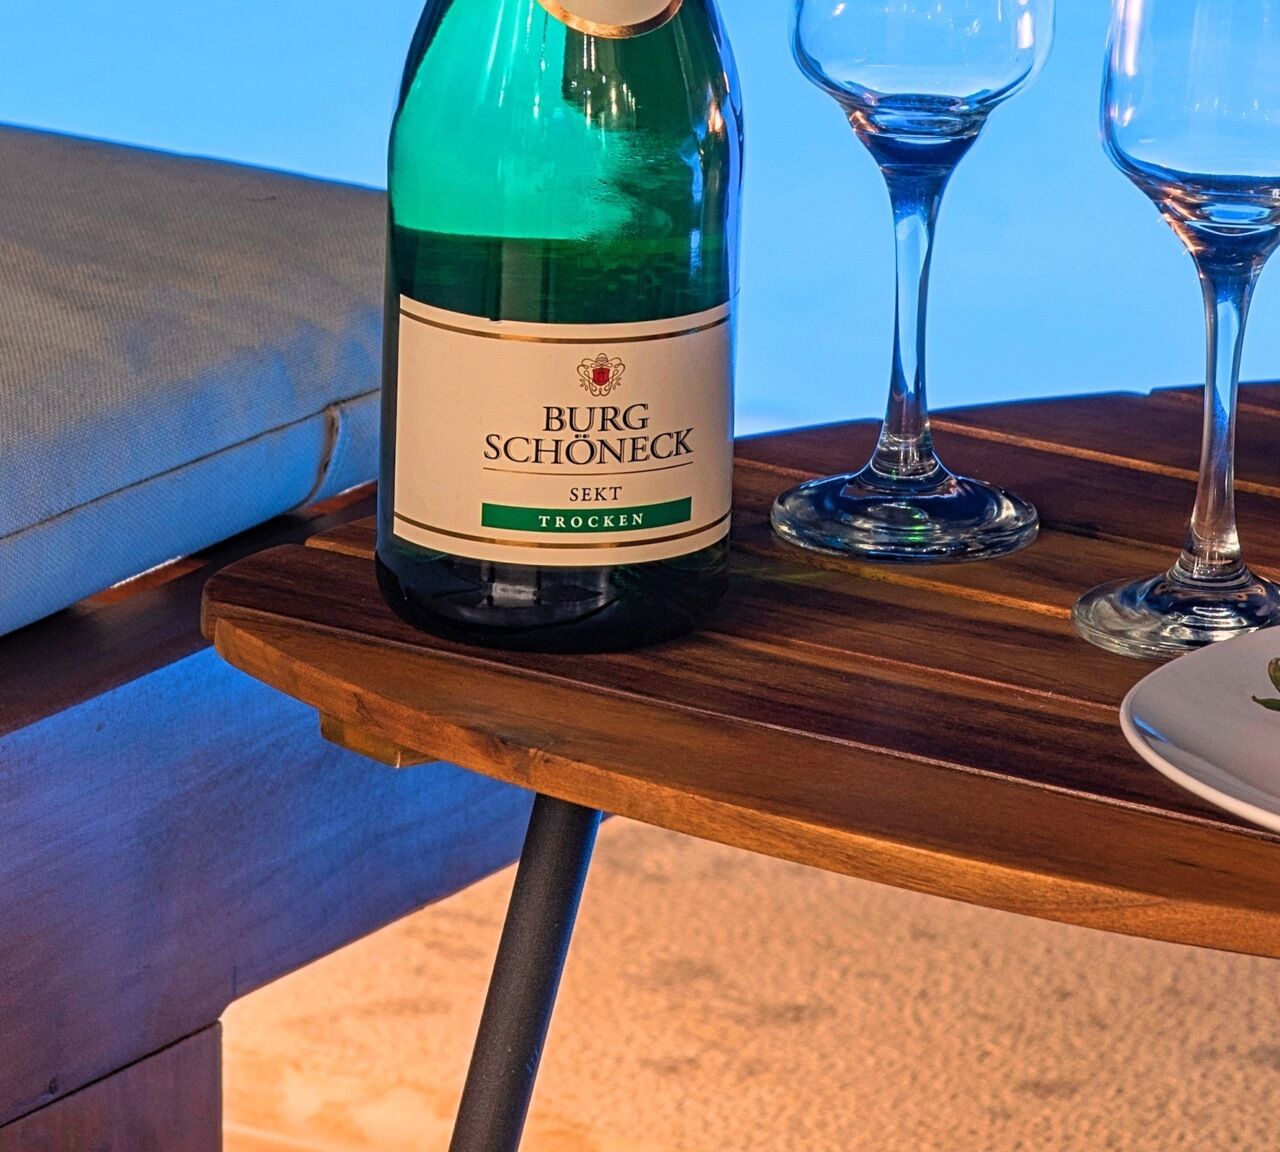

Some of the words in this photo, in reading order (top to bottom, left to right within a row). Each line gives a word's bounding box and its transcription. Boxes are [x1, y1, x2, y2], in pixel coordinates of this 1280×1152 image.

[542, 403, 649, 432] BURG
[483, 427, 694, 465] SCHÖNECK
[569, 486, 623, 502] SEKT
[538, 513, 645, 528] TROCKEN
